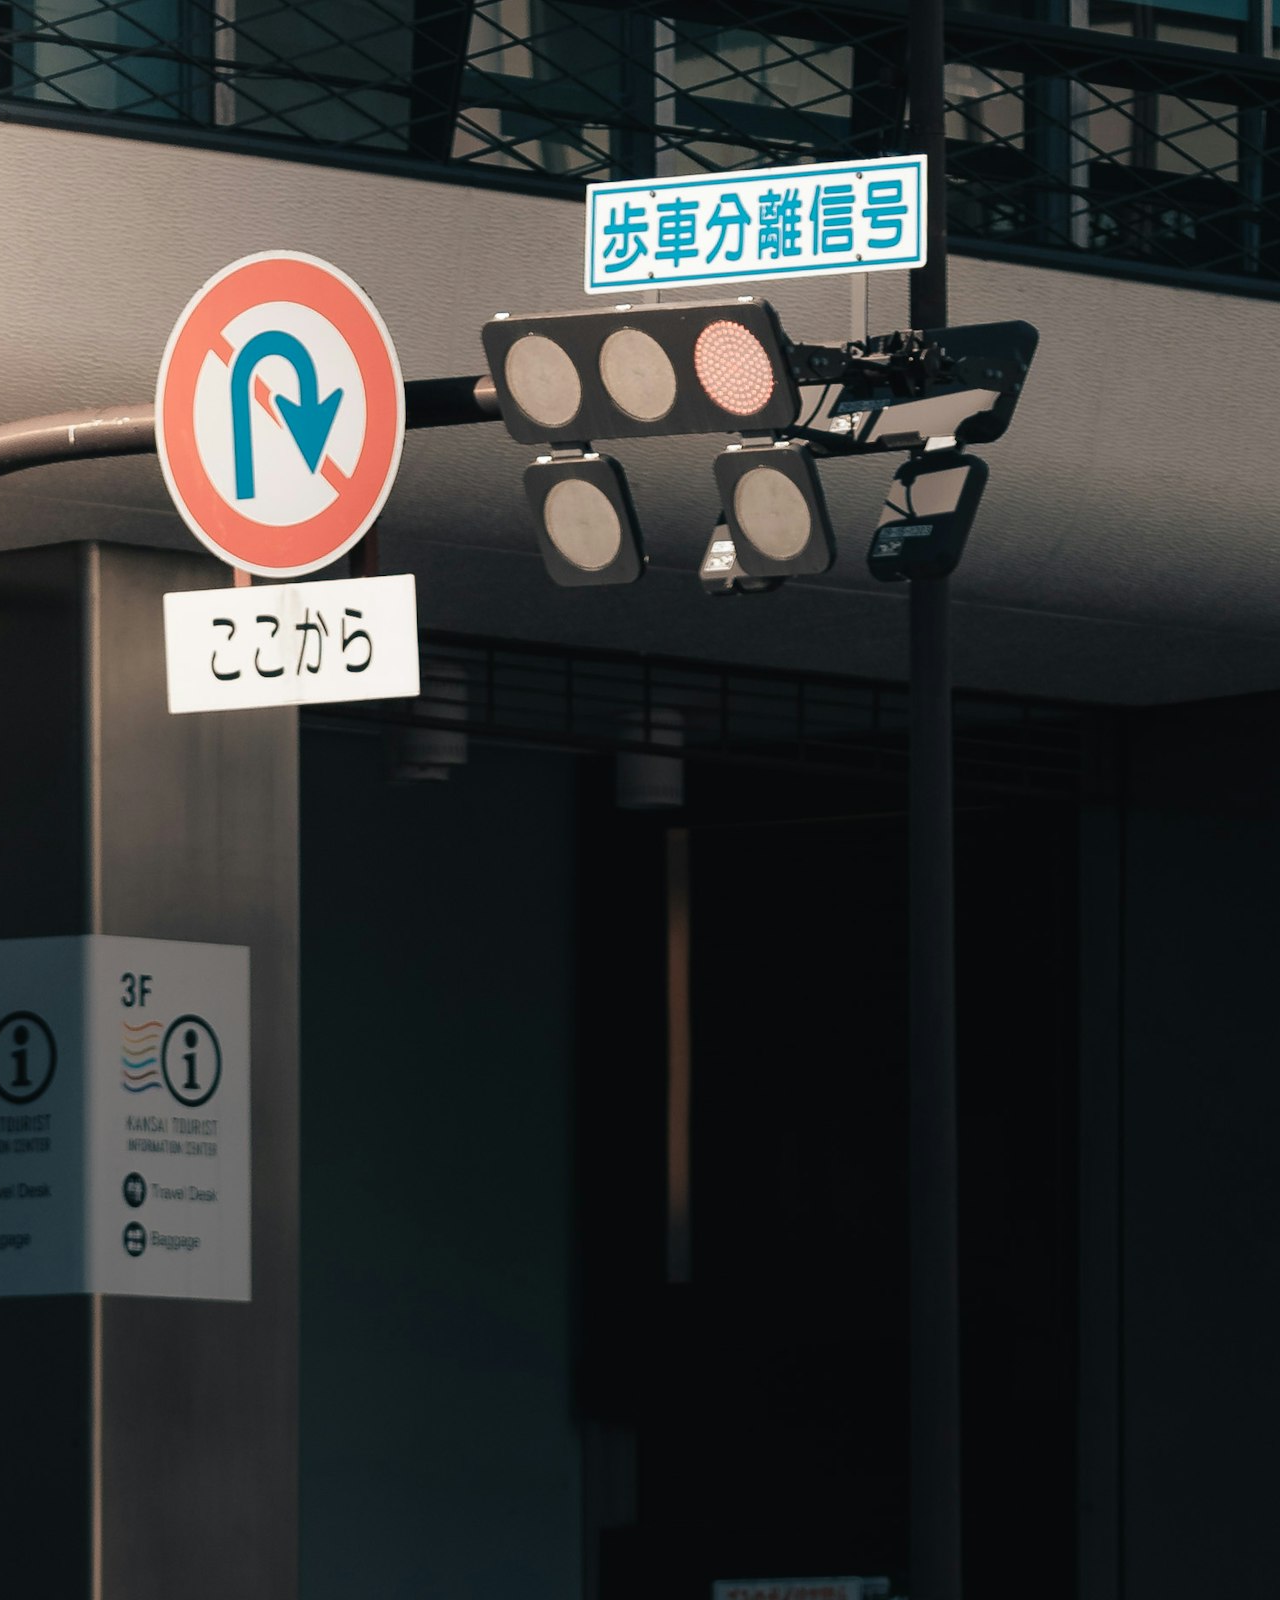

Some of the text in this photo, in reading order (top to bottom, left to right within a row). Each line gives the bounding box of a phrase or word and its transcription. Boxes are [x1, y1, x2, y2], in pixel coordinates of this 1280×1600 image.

[603, 180, 908, 273] 歩車分離信号
[212, 608, 372, 680] ここから
[121, 972, 152, 1007] 3F
[0, 1114, 51, 1133] TOURIST
[126, 1115, 218, 1136] KANSAI TOURIST
[13, 1138, 51, 1153] CENTER
[128, 1138, 217, 1156] INFORMATION CENTER
[17, 1182, 51, 1198] Desk
[151, 1183, 218, 1201] Travel Desk
[151, 1231, 200, 1250] Baggage
